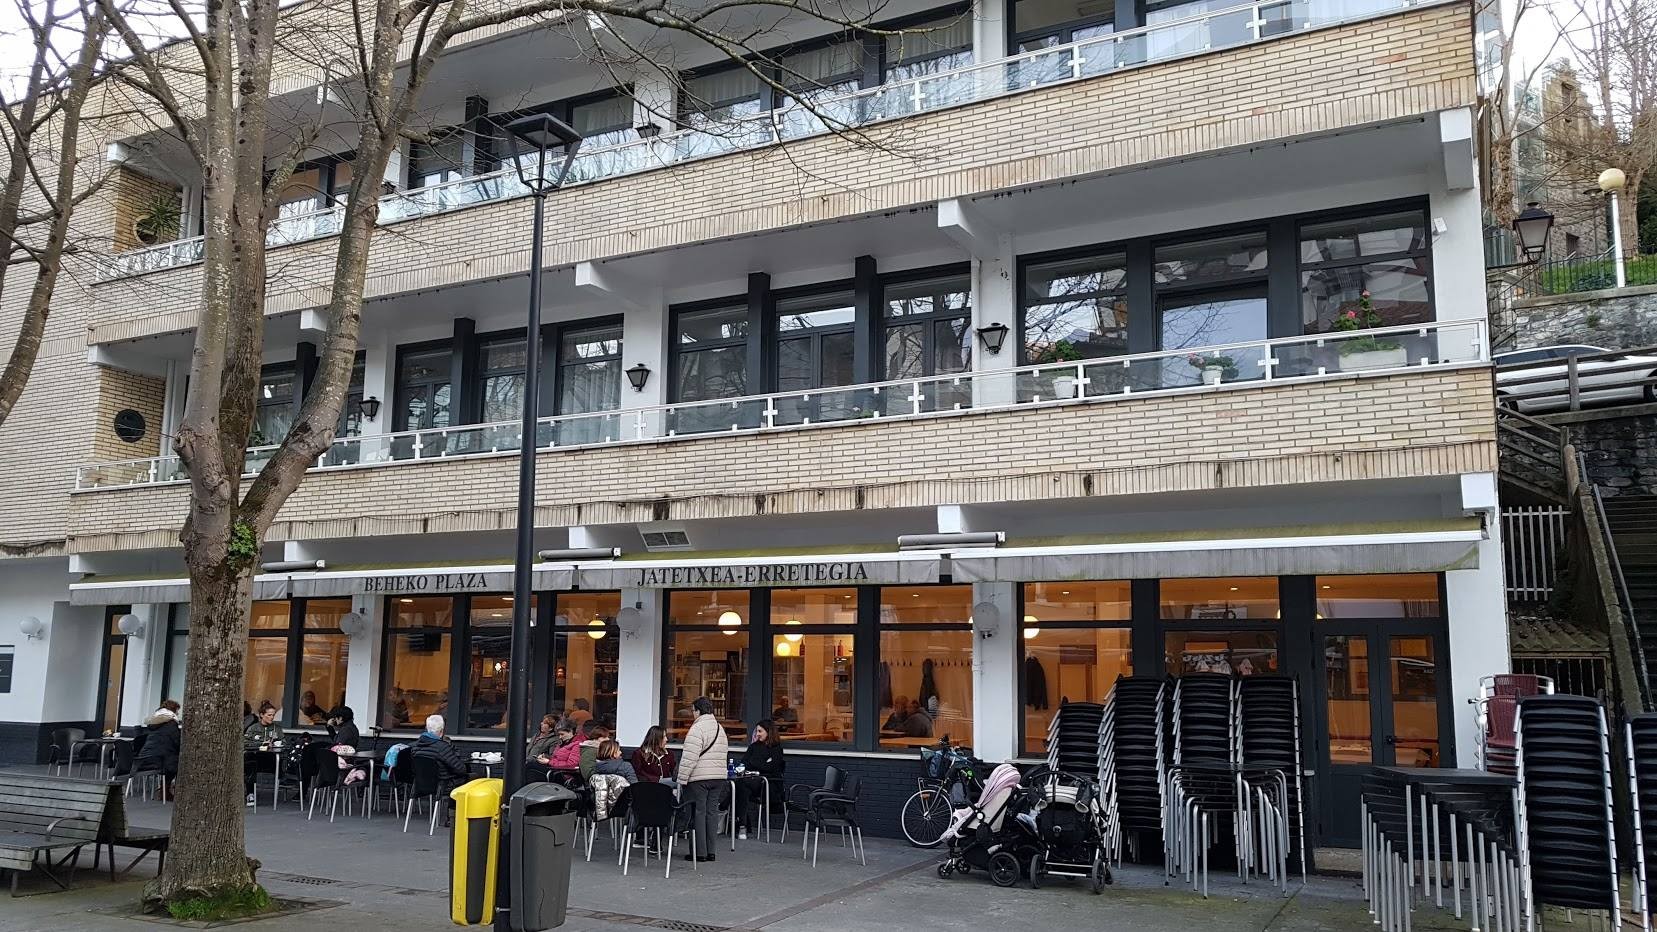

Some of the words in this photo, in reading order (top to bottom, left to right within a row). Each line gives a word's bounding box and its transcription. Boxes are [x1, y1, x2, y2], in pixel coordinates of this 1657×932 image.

[364, 575, 428, 592] BEHEKO
[435, 573, 487, 590] PLAZA
[637, 562, 868, 586] JATETXEA-ERRETEGIA
